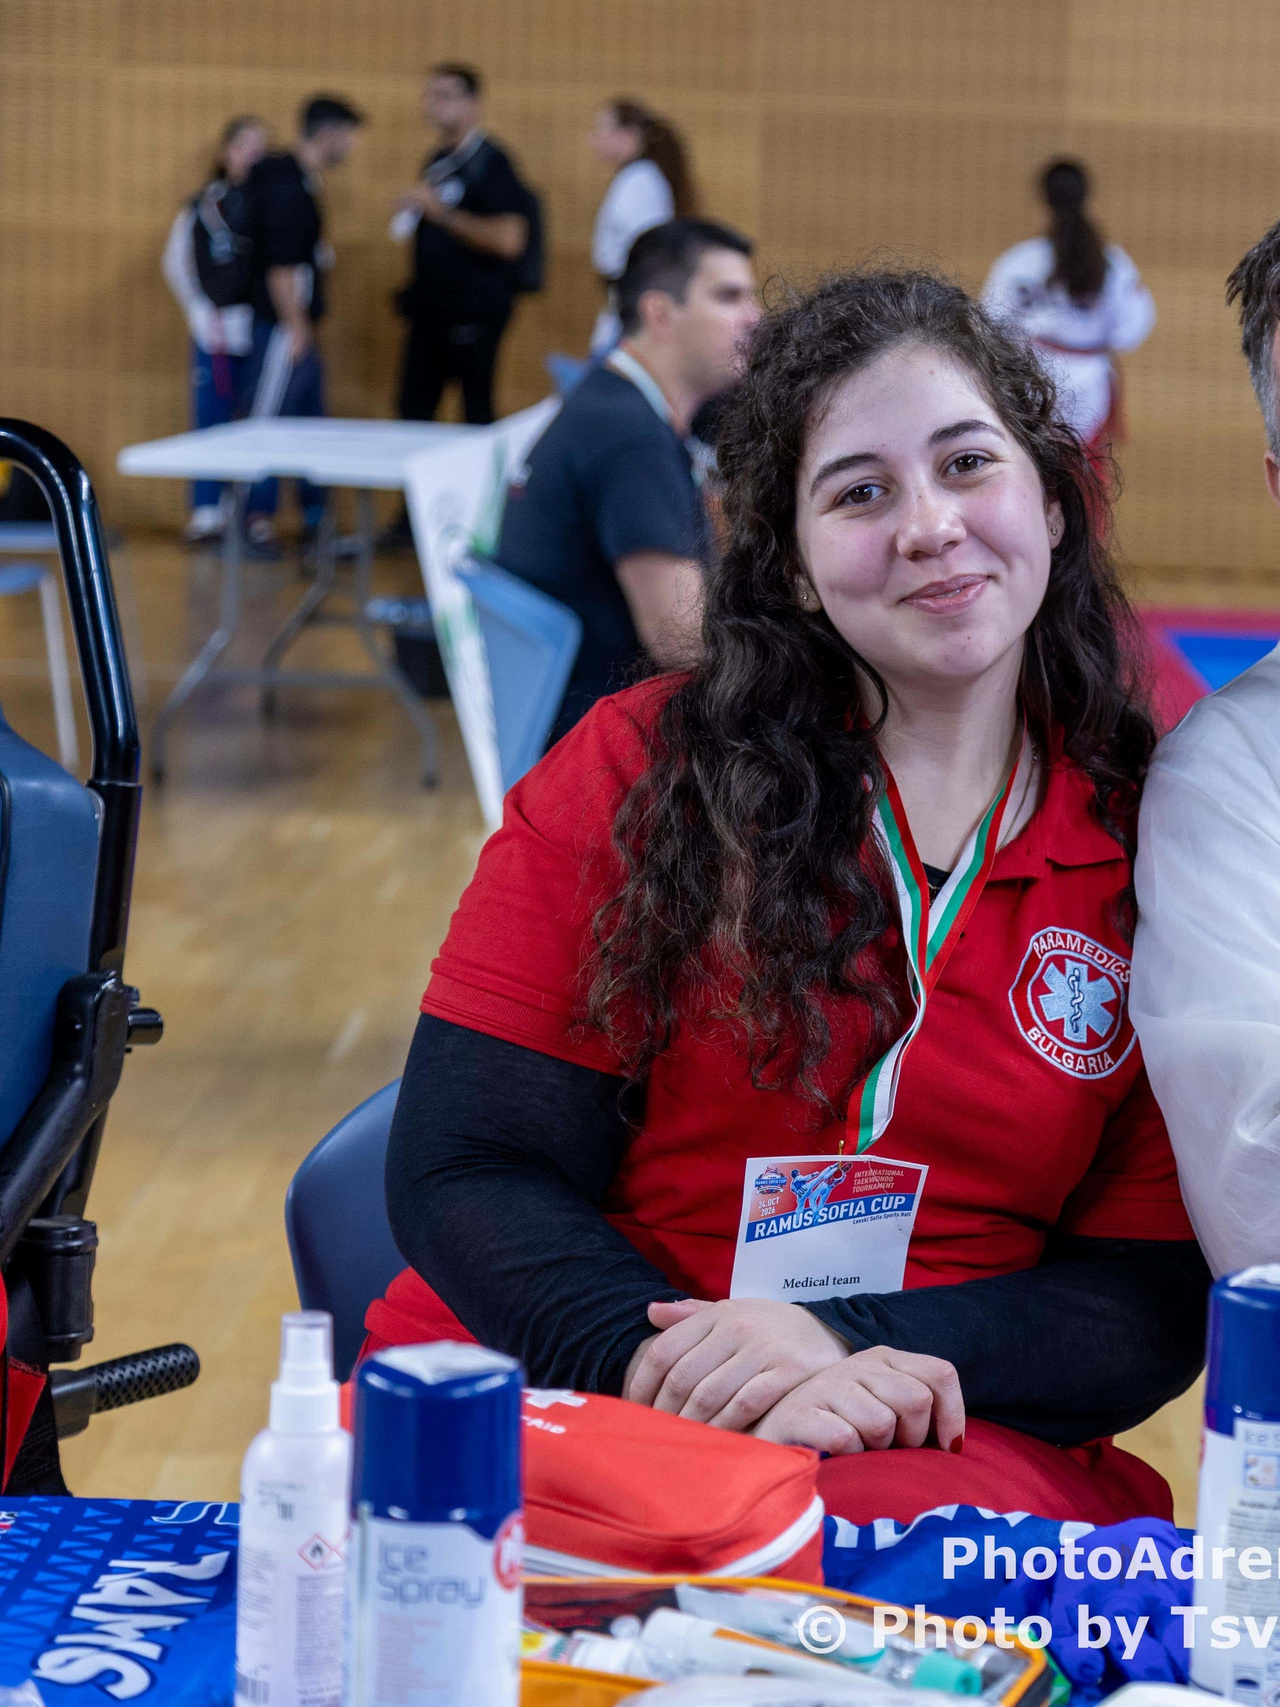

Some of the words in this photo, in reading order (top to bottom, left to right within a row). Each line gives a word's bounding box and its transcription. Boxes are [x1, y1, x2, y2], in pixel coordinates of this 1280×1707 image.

[1033, 932, 1131, 983] PARAMEDICS
[1027, 1026, 1115, 1073] BULGARIA
[852, 1183, 895, 1193] TOURNAMENT
[853, 1176, 894, 1185] TAEKWONDO
[854, 1169, 904, 1178] INTERNATIONAL
[754, 1210, 814, 1239] RAMUS
[818, 1201, 866, 1223] SOFIA
[870, 1196, 906, 1213] CUP
[782, 1275, 829, 1289] Medical
[832, 1276, 860, 1286] team
[379, 1538, 428, 1574] Ice
[377, 1569, 488, 1609] Spray
